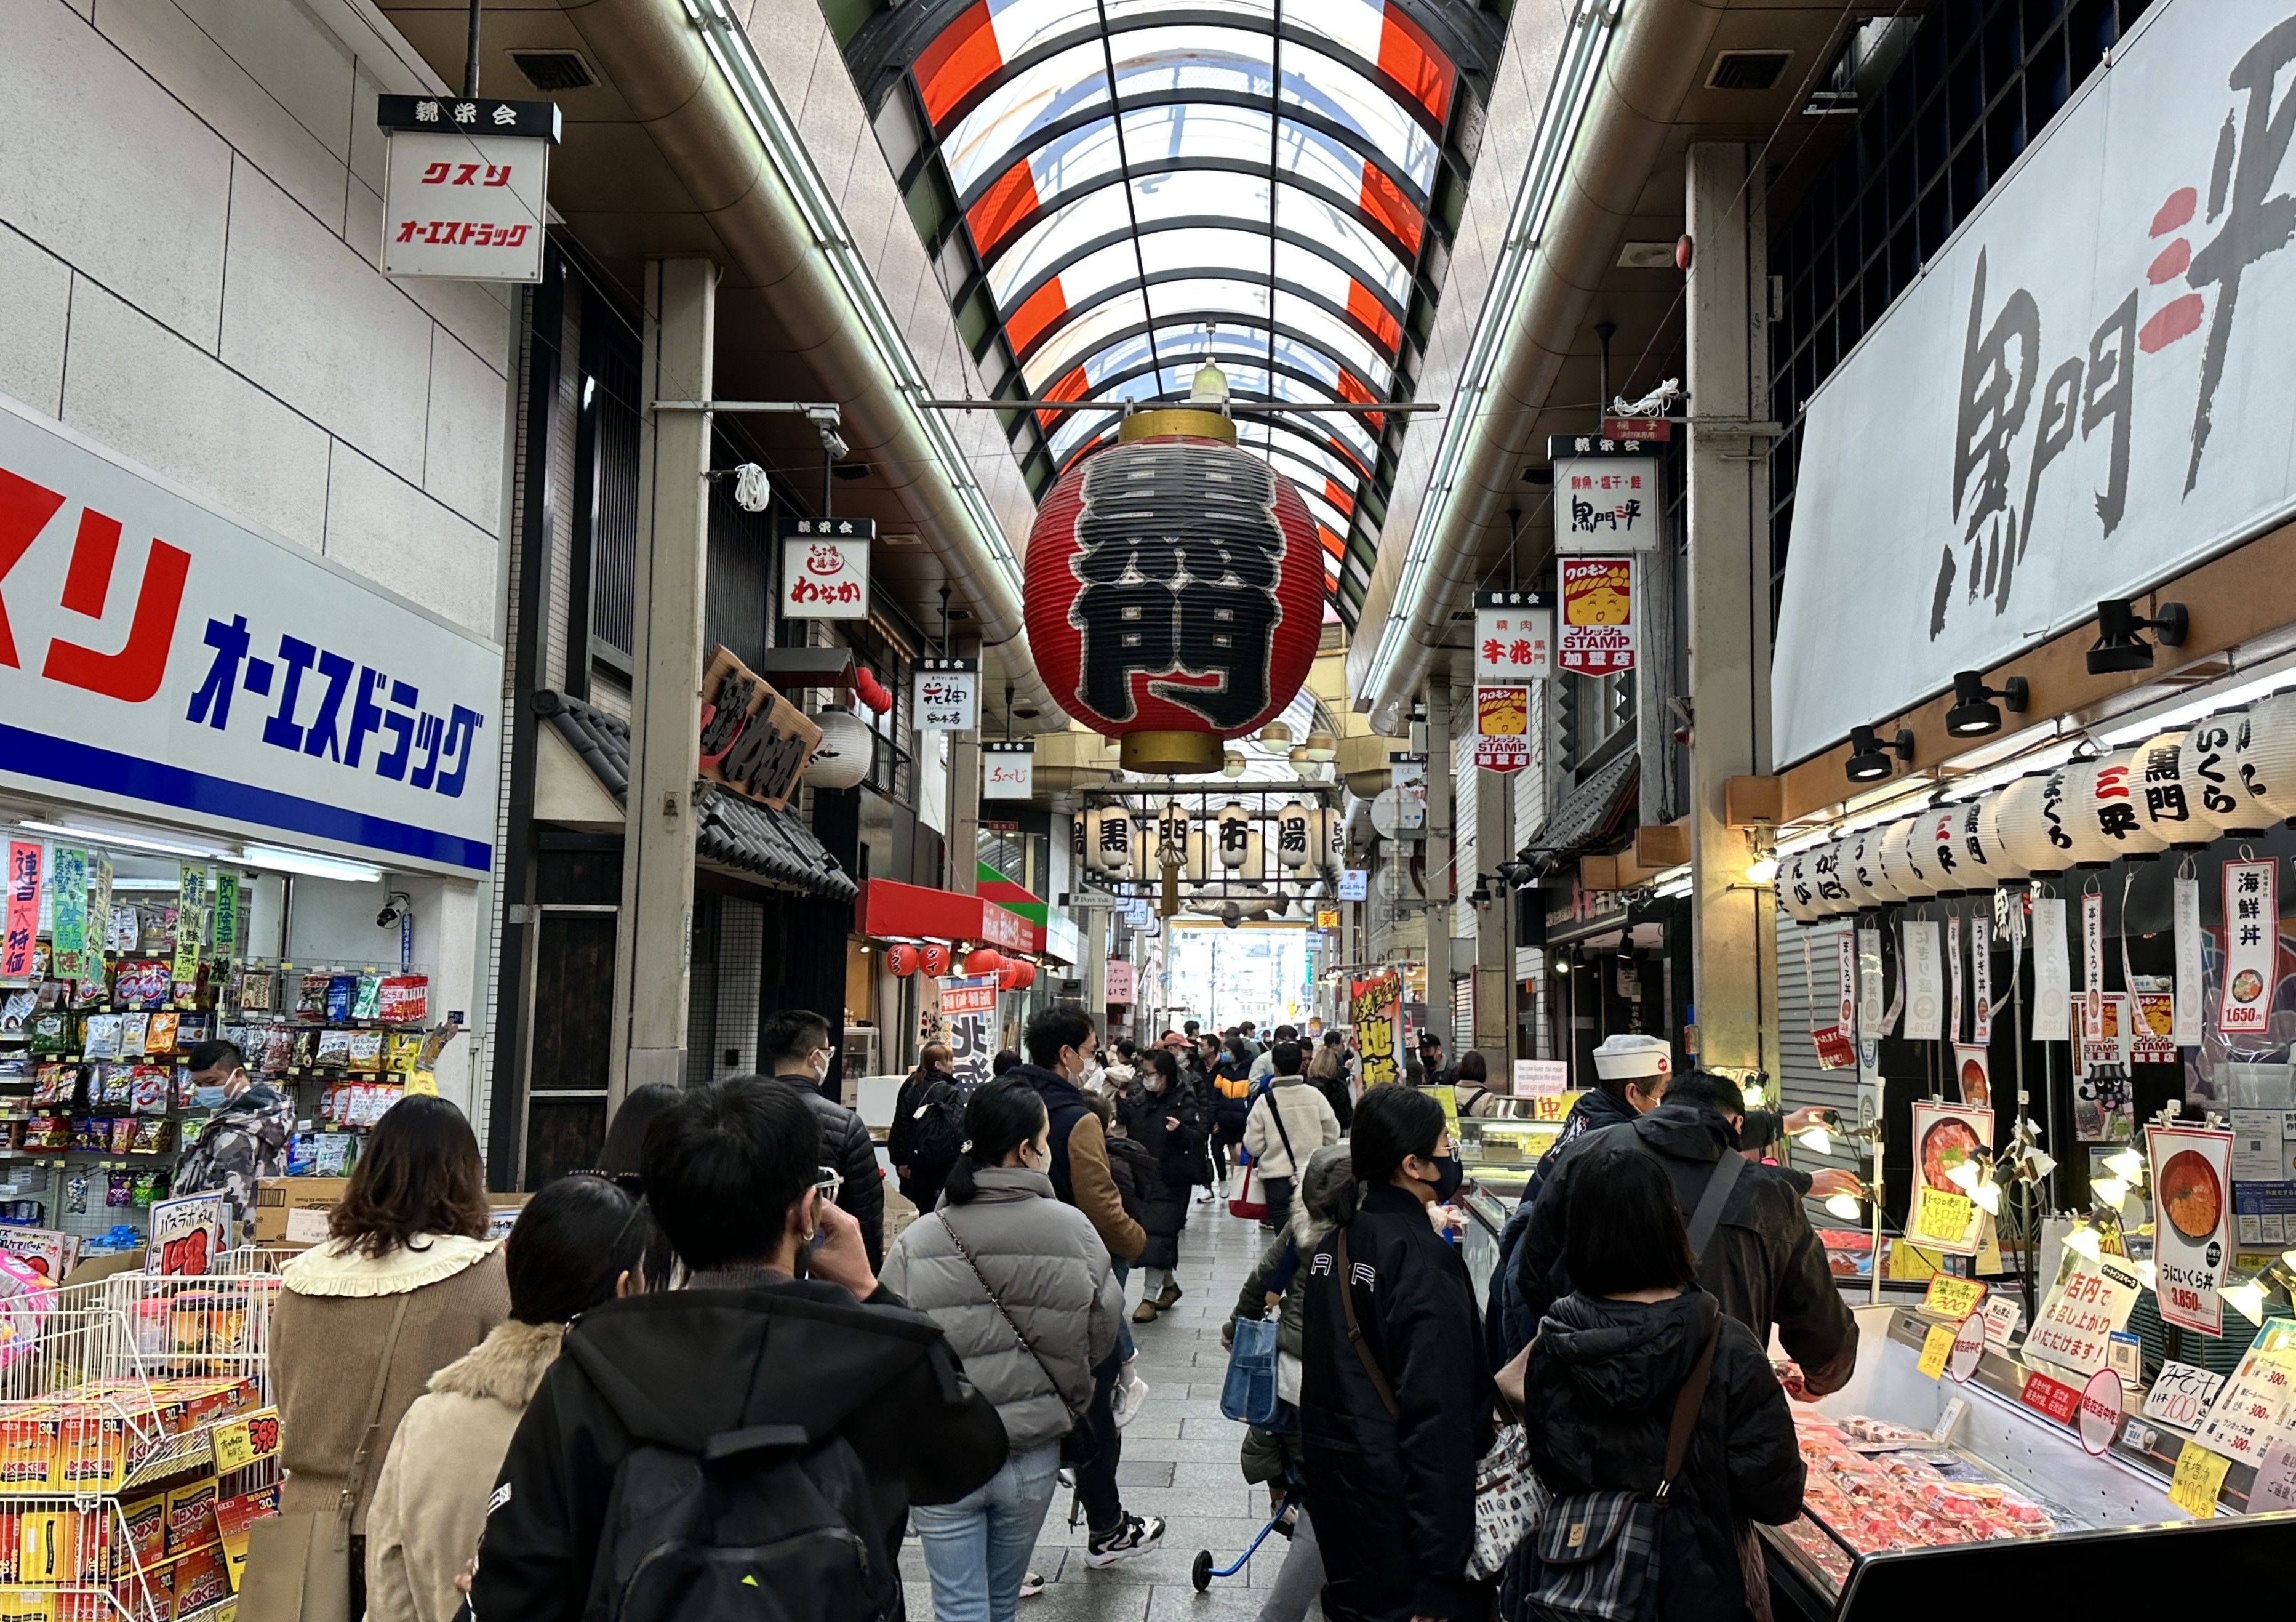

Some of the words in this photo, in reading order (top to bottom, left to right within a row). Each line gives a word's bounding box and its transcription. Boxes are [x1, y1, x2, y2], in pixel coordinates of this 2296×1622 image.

[422, 163, 512, 187] クスリ
[396, 220, 532, 247] オーエスドラッグ
[1571, 475, 1641, 490] 鮮魚・塩干・鮭
[1572, 494, 1641, 532] 黒門三平
[1566, 564, 1608, 580] クロモン
[791, 576, 860, 604] わなか
[1496, 620, 1532, 632] 精肉
[1569, 625, 1623, 636] フレッシュ
[1534, 640, 1546, 665] 黒門
[1564, 636, 1630, 649] STAMP
[1564, 651, 1631, 667] 加盟店
[186, 614, 484, 798] オーエスドラッグ
[1479, 687, 1511, 700] クロモン
[1478, 743, 1527, 753] STAMP
[1482, 734, 1521, 744] フレッシュ
[1479, 754, 1527, 766] 加盟店
[2197, 728, 2236, 814] いくら
[2145, 745, 2190, 823] 黒門
[2043, 774, 2073, 849] まぐろ
[2096, 766, 2140, 840] 三平
[1100, 817, 1306, 853] 黒門市場
[2238, 872, 2261, 946] 海鮮丼
[2088, 905, 2098, 986] 本まぐろ丼
[890, 947, 902, 974] イクラ
[926, 947, 940, 972] タイ
[1843, 941, 1852, 996] まぐろ丼
[1977, 925, 1986, 993] うなぎ丼
[2226, 1007, 2262, 1024] 1,650円
[399, 1035, 409, 1048] V
[2084, 1044, 2119, 1052] STAMP
[2133, 1042, 2174, 1051] STAMP
[393, 1057, 403, 1070] C
[2134, 1053, 2175, 1062] 加盟店
[162, 1227, 208, 1275] 198
[2064, 1272, 2112, 1306] 店内で
[2102, 1264, 2137, 1288] イートインスペース
[2162, 1263, 2214, 1292] うにいくら丼
[2170, 1287, 2203, 1312] 3,850円
[2046, 1303, 2111, 1336] お召し上がり
[2160, 1364, 2217, 1401] みそ汁
[2160, 1394, 2197, 1423] 100
[248, 1417, 279, 1455] 398
